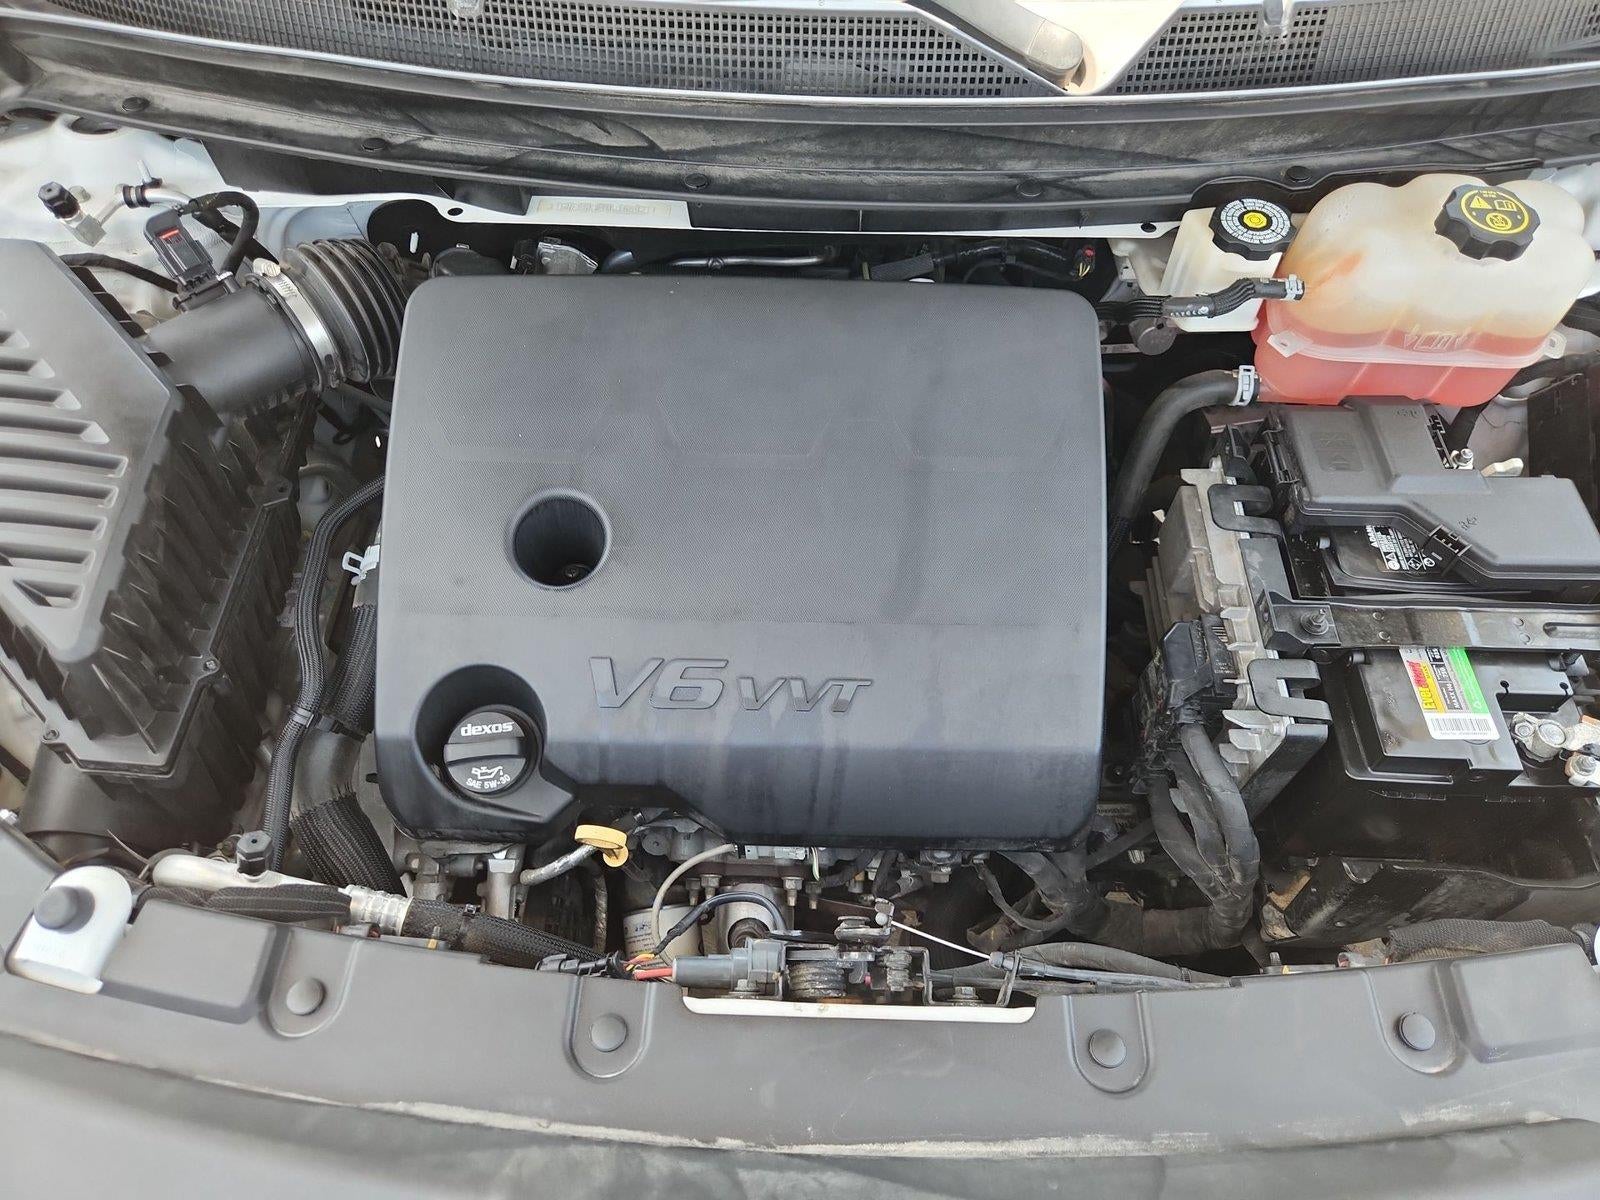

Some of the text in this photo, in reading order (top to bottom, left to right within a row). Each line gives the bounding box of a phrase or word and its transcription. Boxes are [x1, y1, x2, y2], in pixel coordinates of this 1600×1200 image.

[589, 656, 873, 713] V6 VVT
[460, 721, 515, 737] dexos
[466, 774, 511, 790] SAE 5W-30
